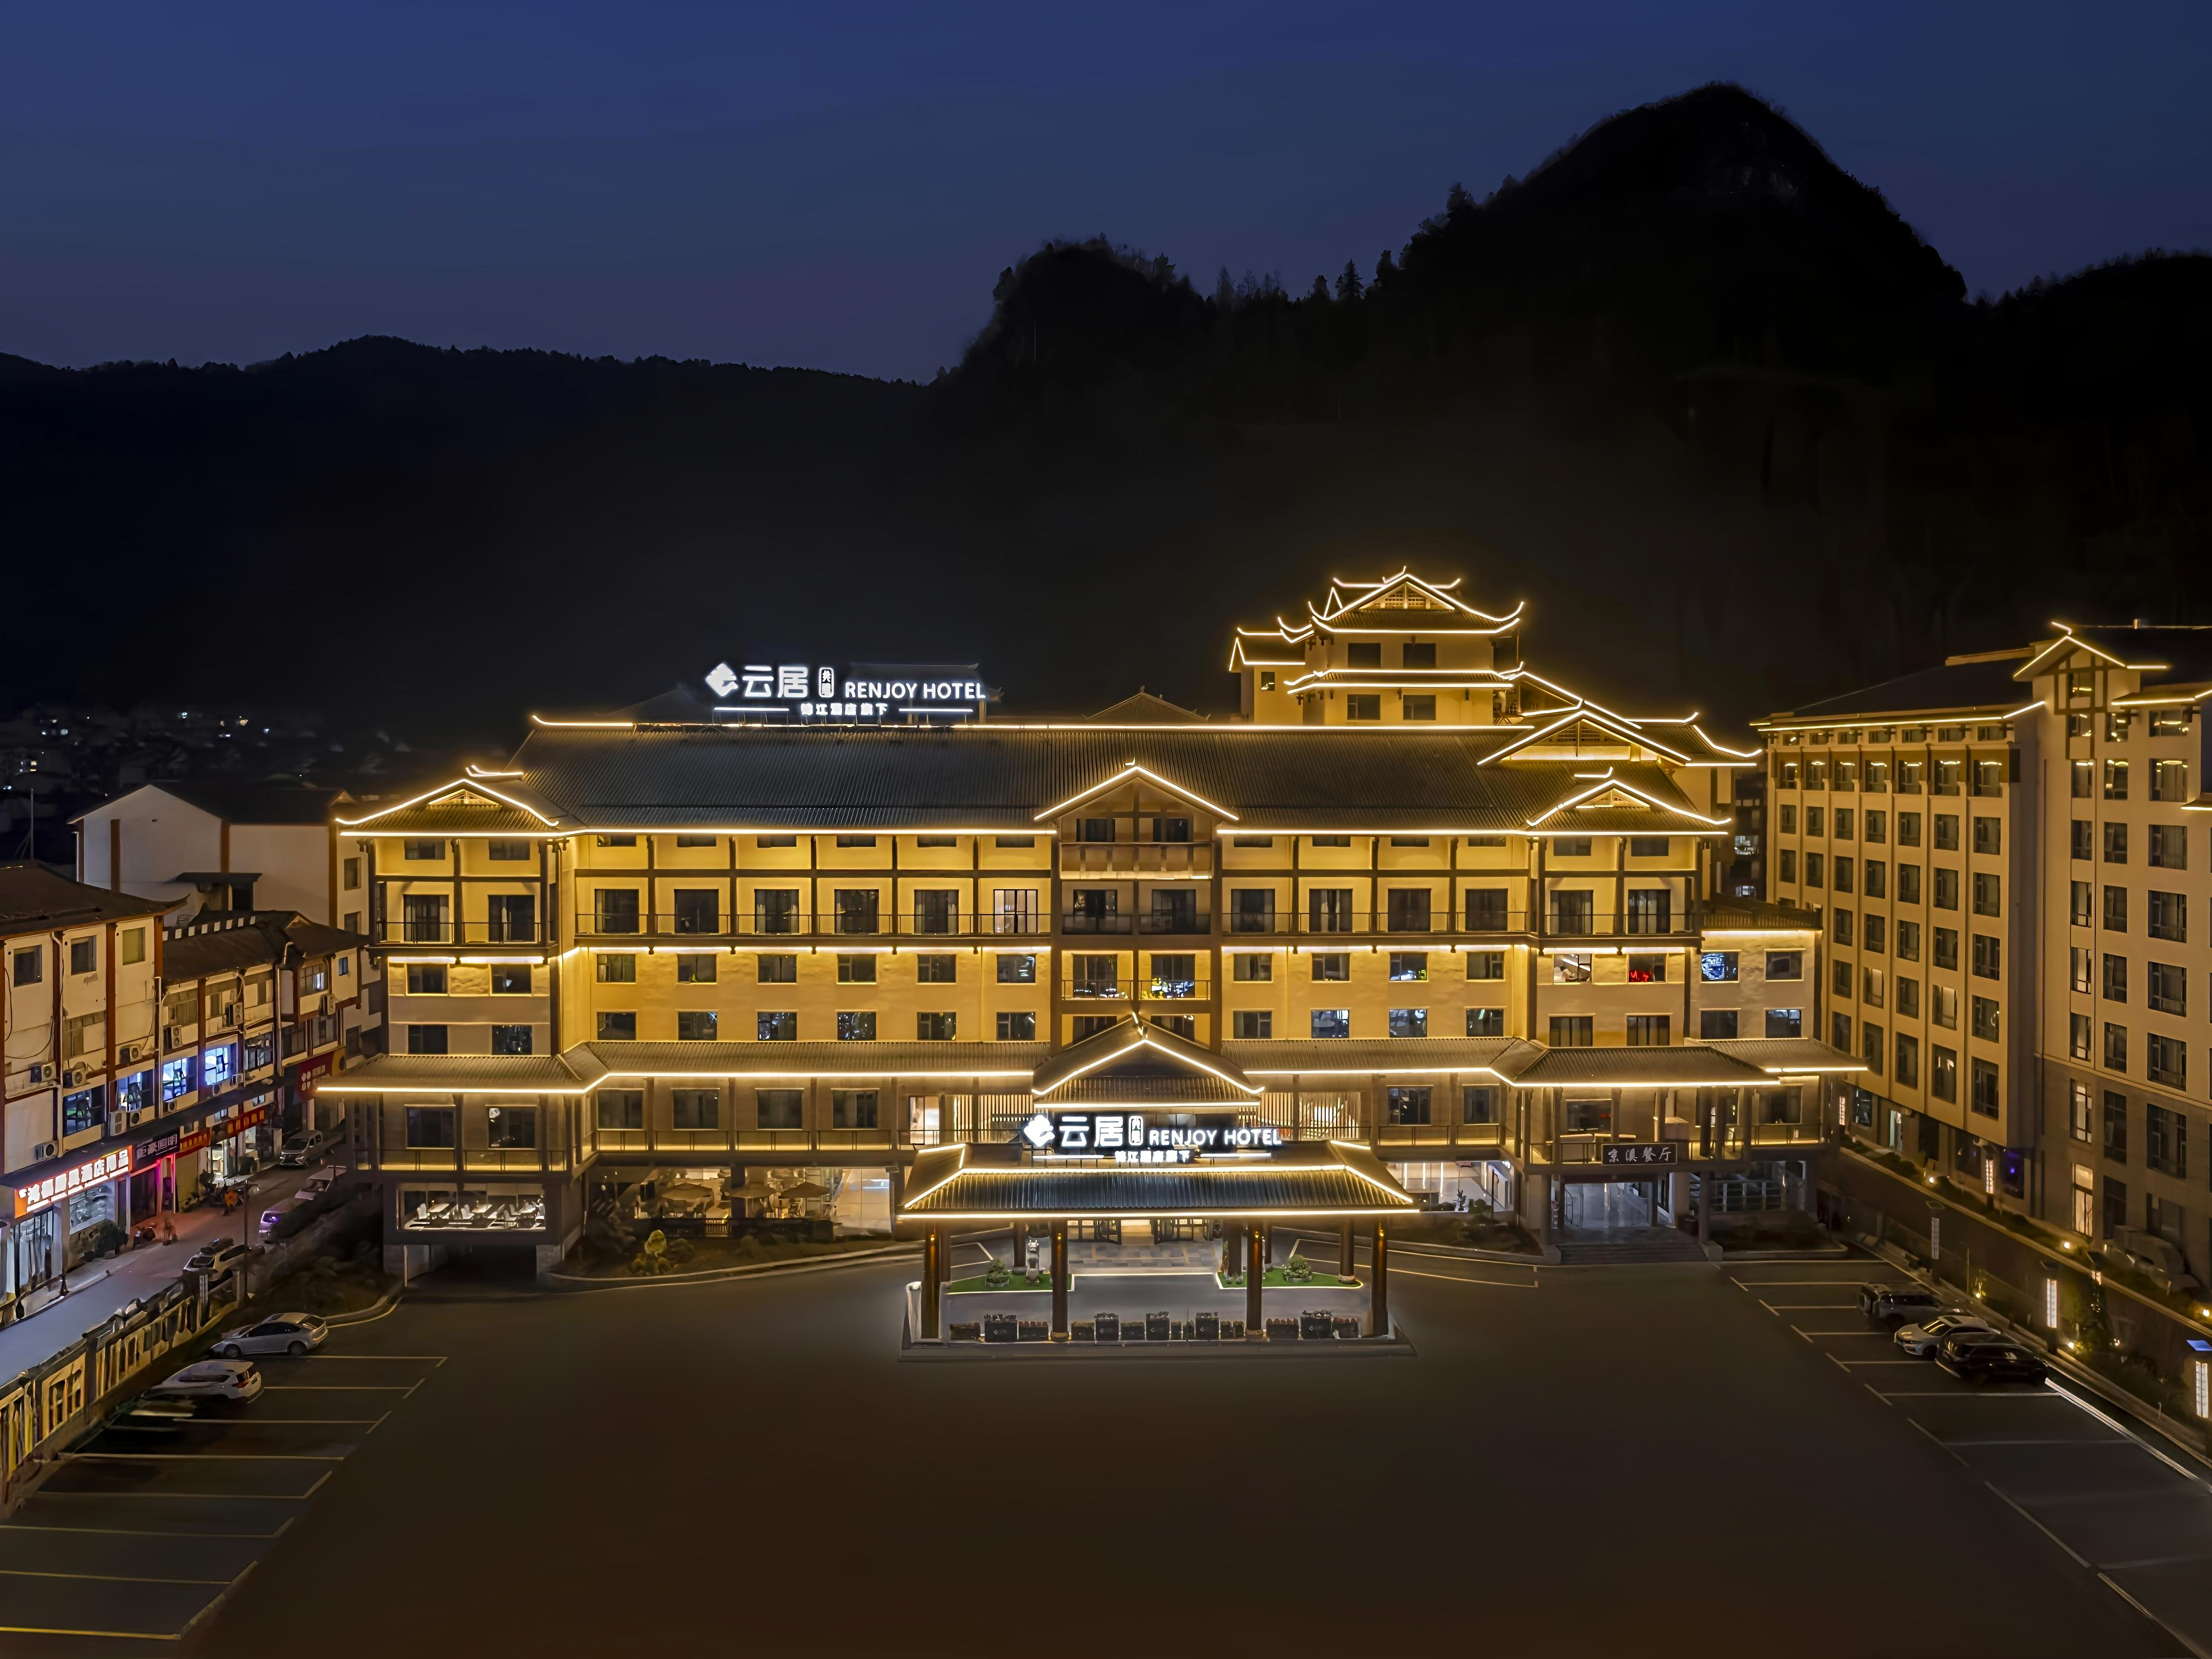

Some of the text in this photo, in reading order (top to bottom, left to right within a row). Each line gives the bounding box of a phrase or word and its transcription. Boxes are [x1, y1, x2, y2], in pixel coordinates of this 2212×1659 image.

[742, 666, 808, 698] 云居
[845, 682, 986, 699] RENJOY HOTEL
[1059, 1116, 1123, 1146] 云居
[1149, 1129, 1217, 1146] RENJOY
[1224, 1128, 1282, 1145] HOTEL
